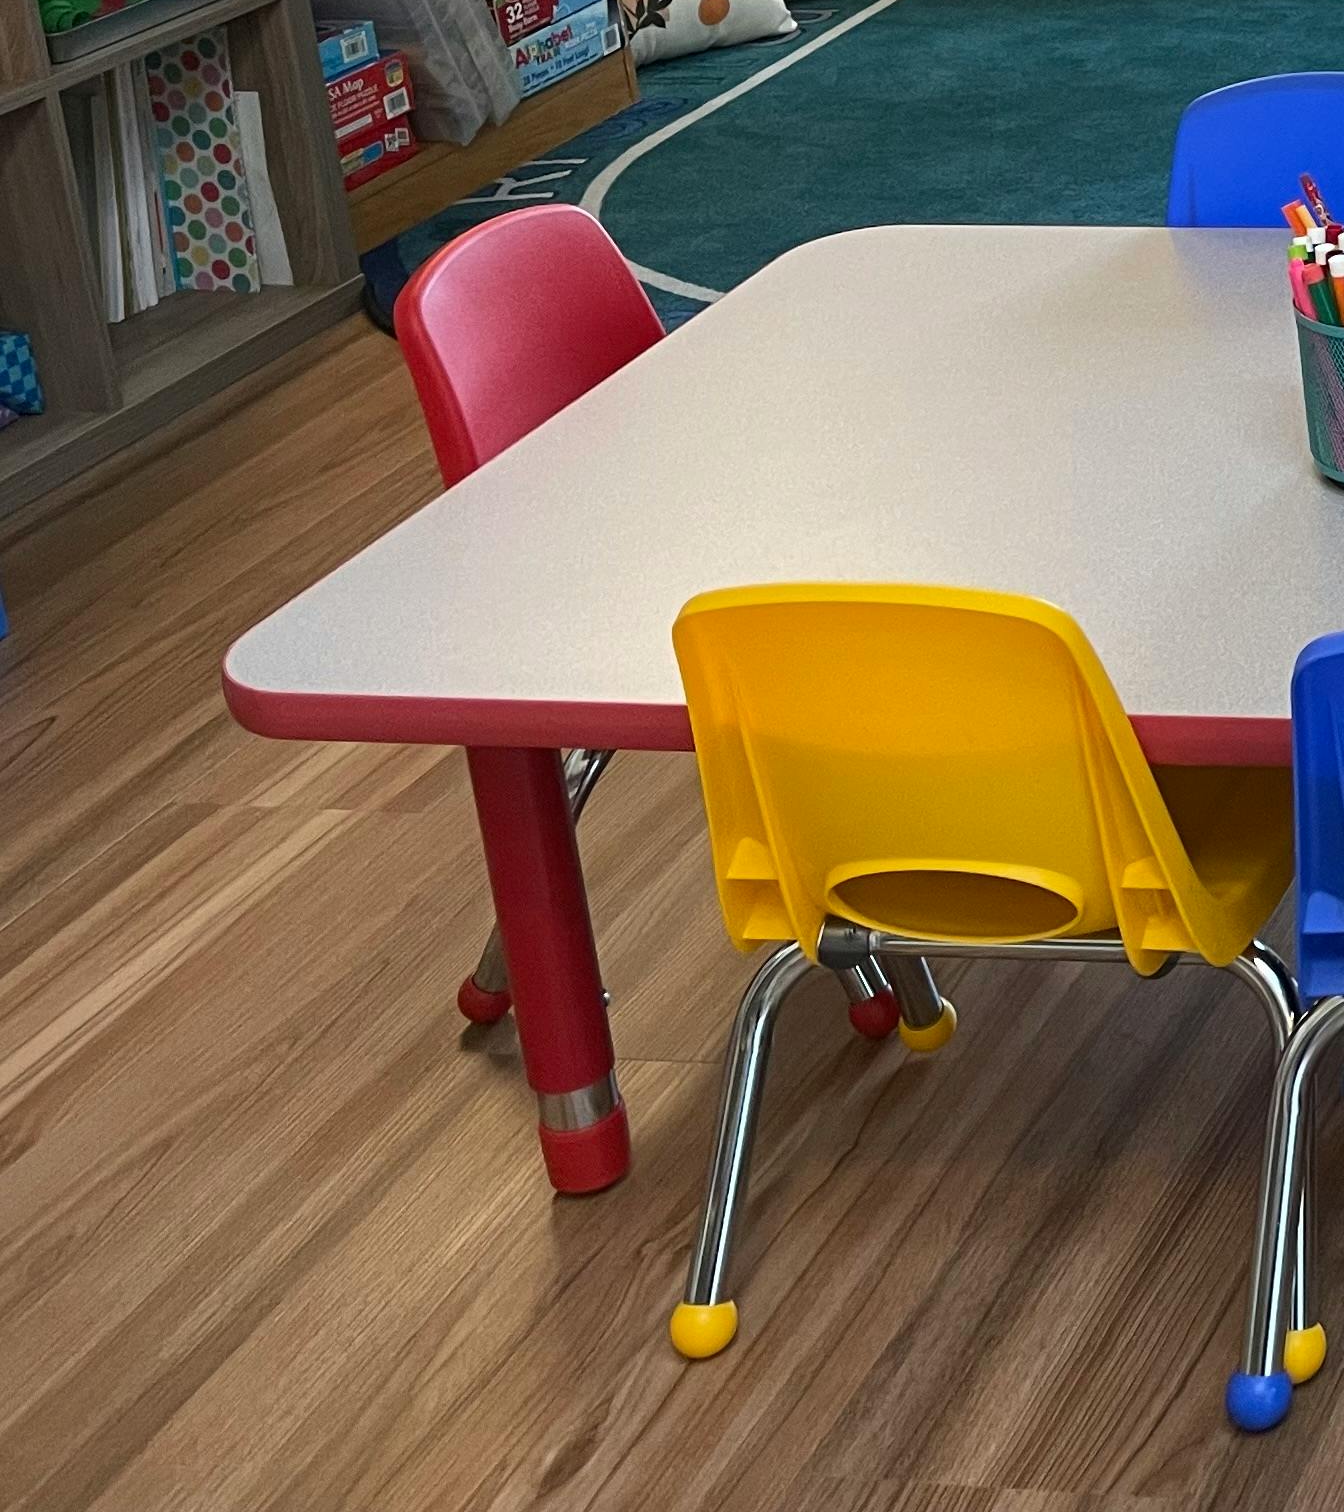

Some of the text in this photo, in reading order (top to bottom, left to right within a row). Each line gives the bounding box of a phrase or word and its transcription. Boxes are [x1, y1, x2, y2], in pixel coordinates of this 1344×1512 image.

[505, 2, 524, 24] 32
[515, 24, 573, 69] Alphabet
[343, 78, 364, 94] Map
